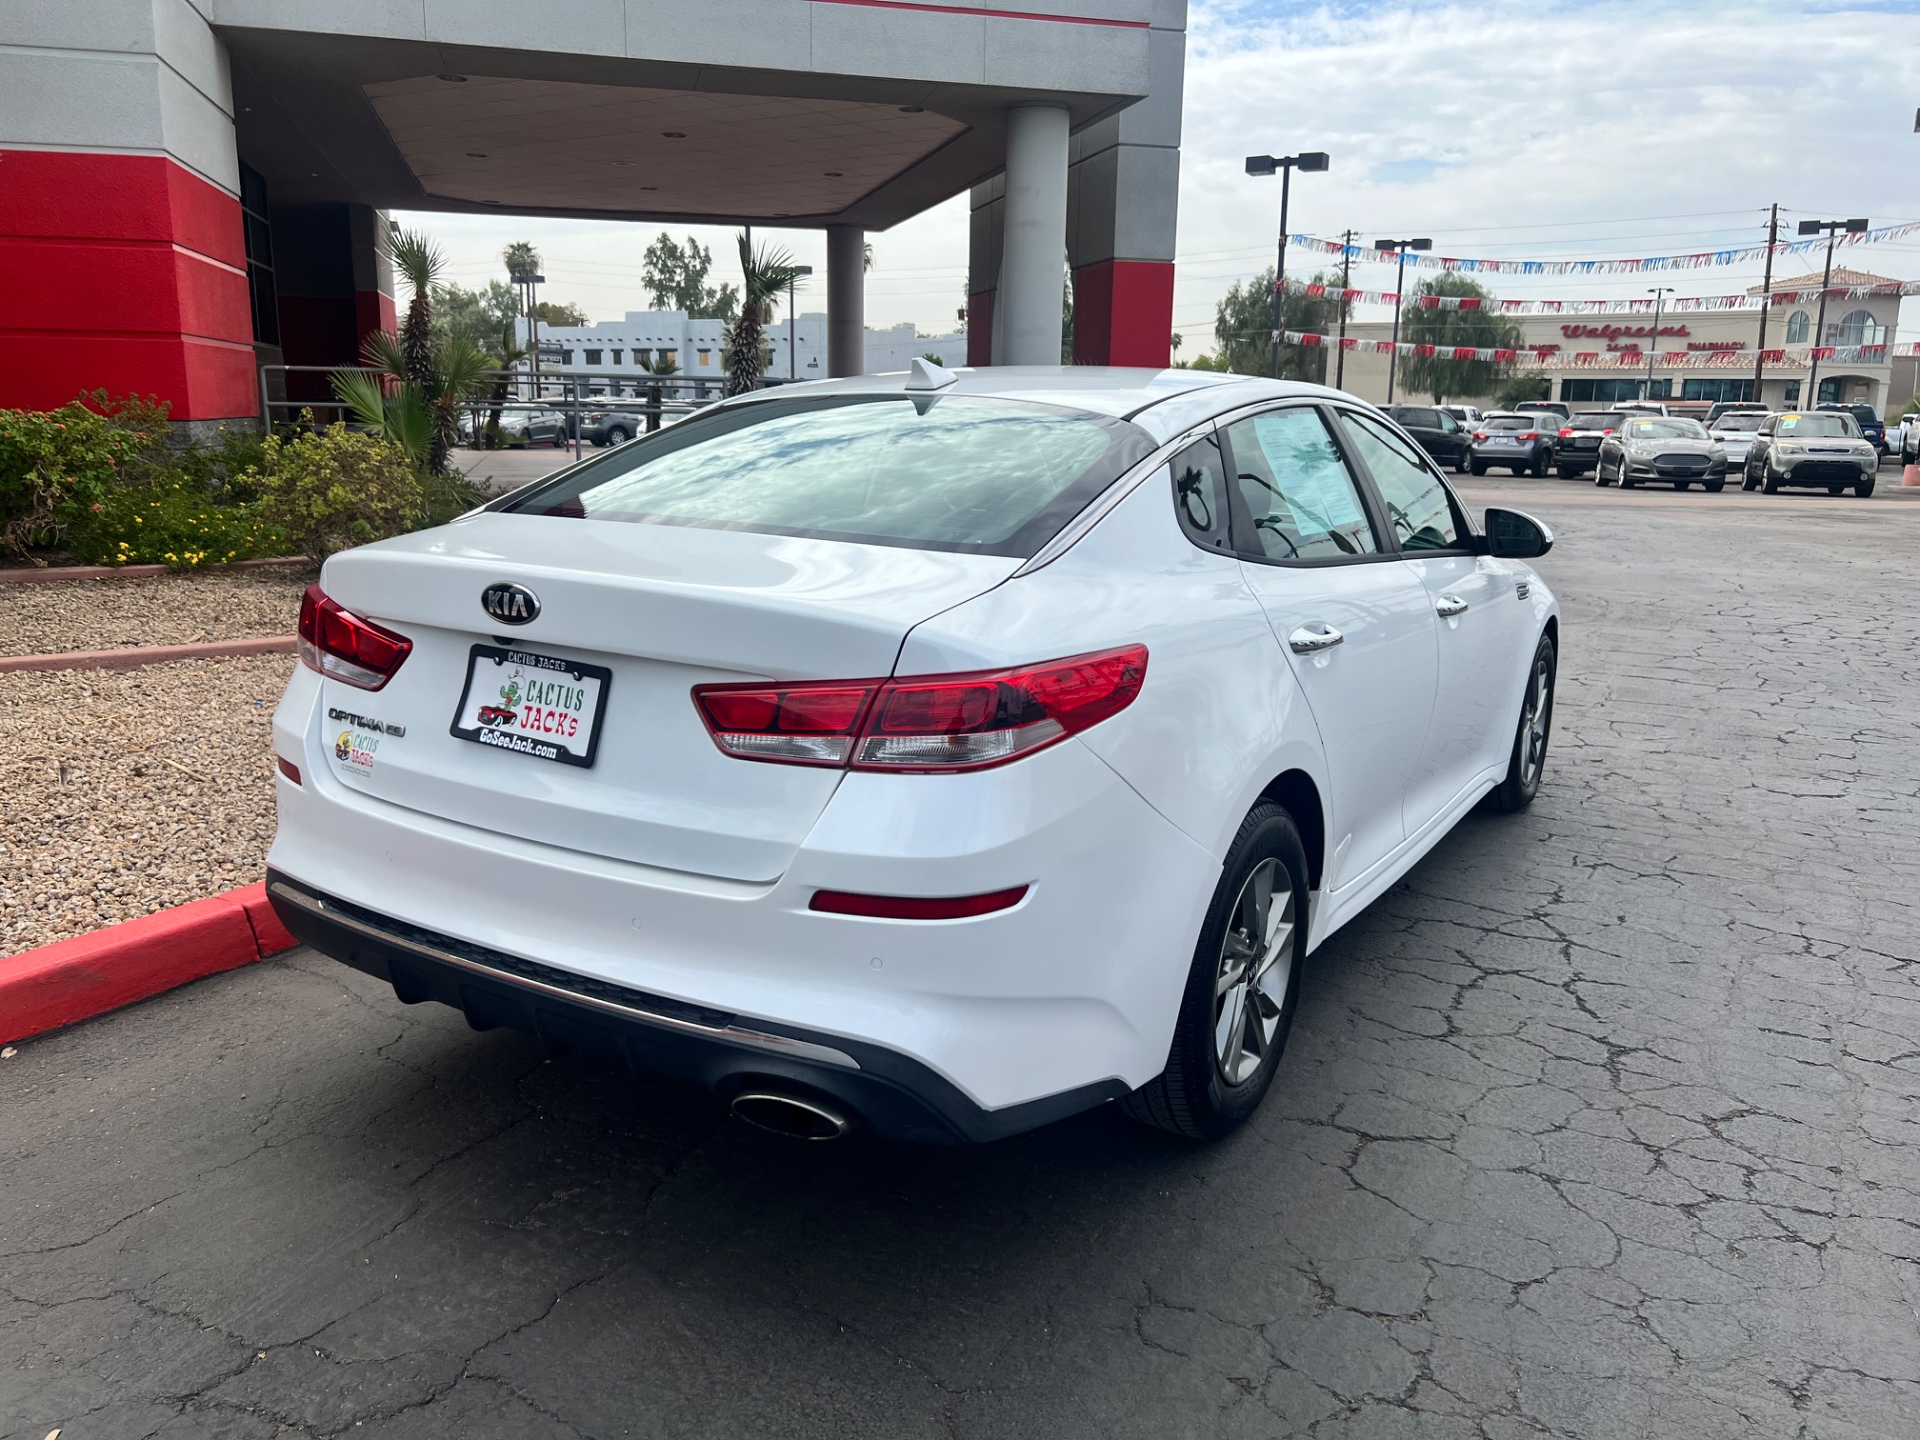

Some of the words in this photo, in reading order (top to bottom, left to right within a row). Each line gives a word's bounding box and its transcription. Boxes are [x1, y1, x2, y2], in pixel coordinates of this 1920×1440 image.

[1560, 324, 1691, 342] Walgreens
[1686, 341, 1746, 351] PHARMACY
[488, 590, 529, 618] KIA
[507, 651, 536, 666] CACTUS
[525, 679, 584, 712] CACTUS
[328, 707, 385, 734] OPTIMA
[520, 705, 579, 737] JACK'S
[353, 733, 380, 754] CACTUS
[479, 728, 558, 760] GoSeeJack.com
